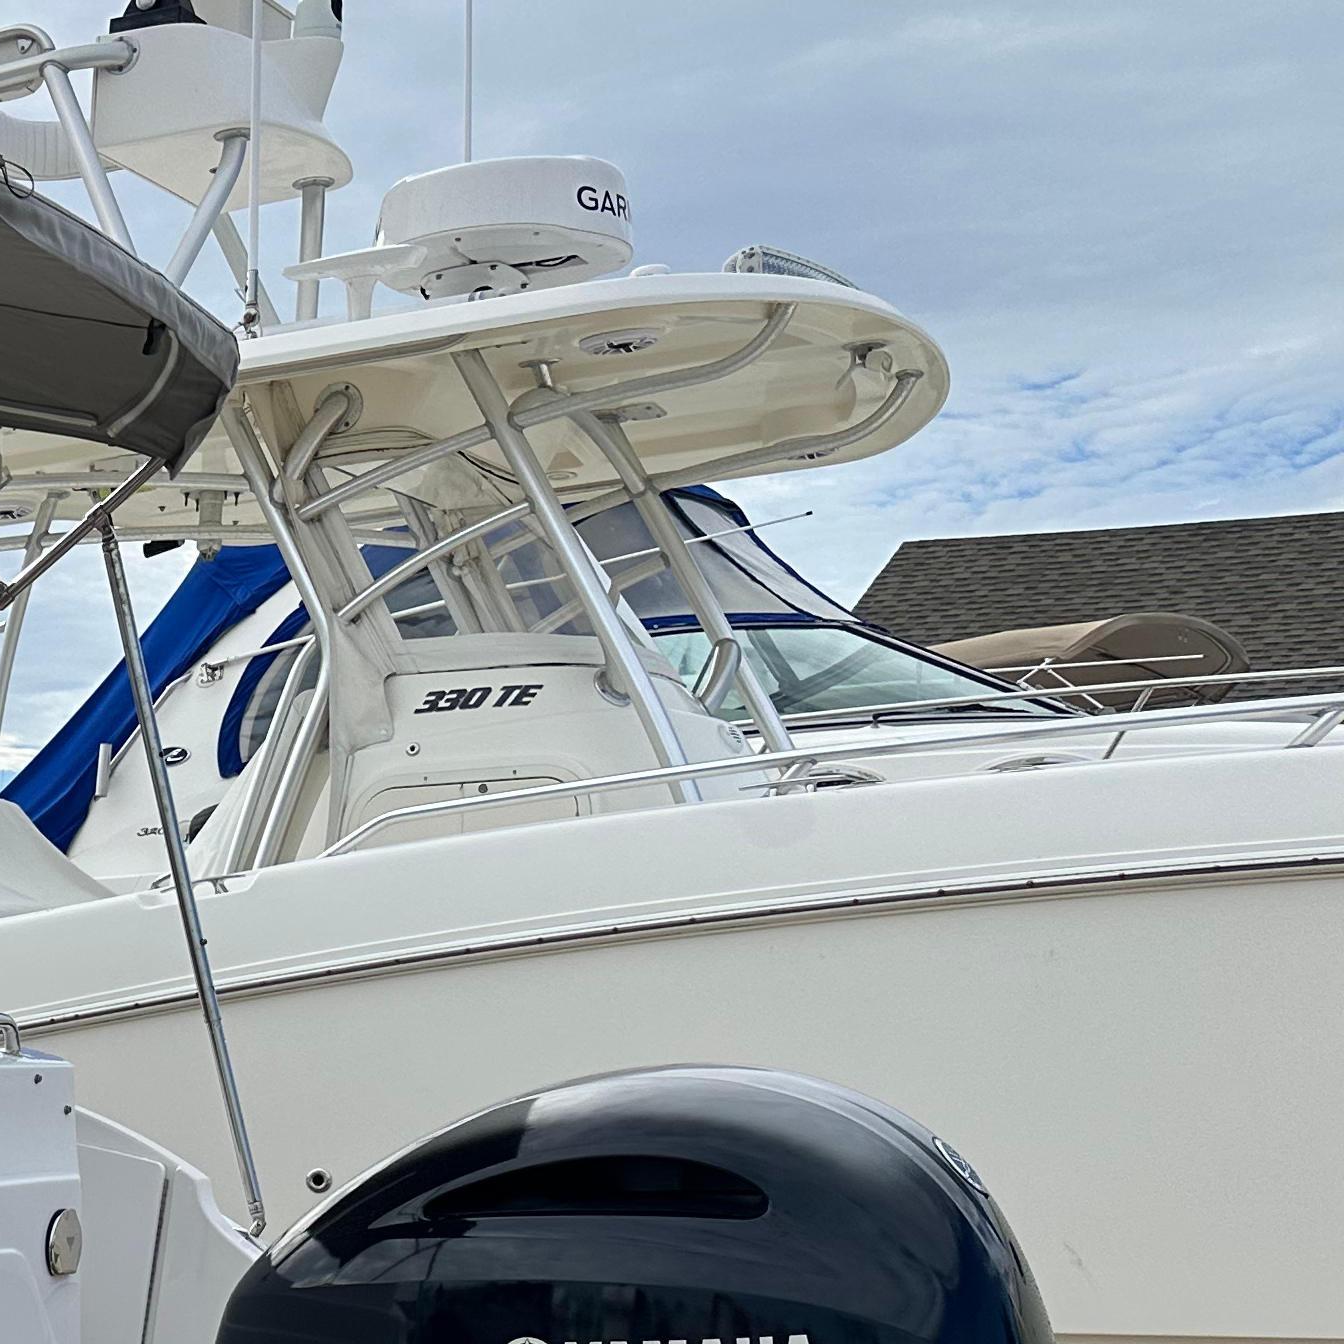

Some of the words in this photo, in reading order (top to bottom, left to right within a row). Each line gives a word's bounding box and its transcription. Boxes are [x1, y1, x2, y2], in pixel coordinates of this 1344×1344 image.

[577, 186, 631, 222] GAR
[414, 687, 492, 714] 330
[493, 685, 544, 707] TE
